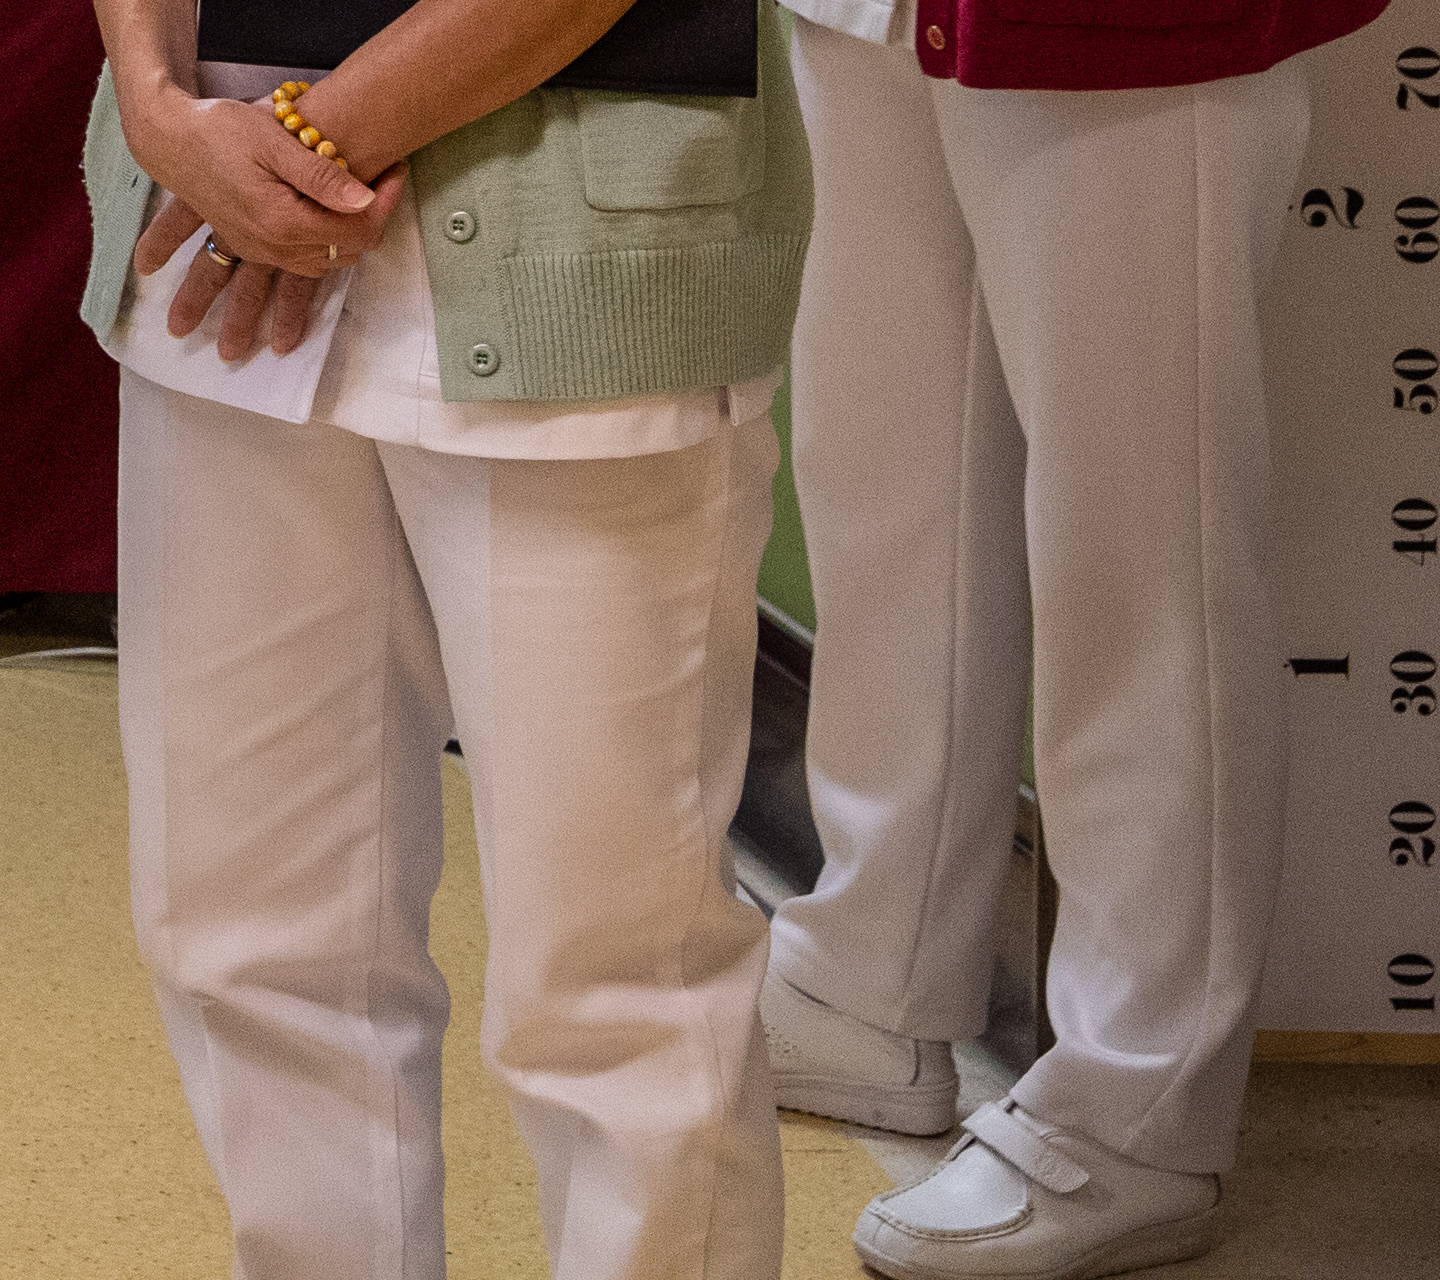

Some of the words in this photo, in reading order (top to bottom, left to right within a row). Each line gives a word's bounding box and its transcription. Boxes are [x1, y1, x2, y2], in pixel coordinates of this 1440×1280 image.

[1395, 46, 1440, 112] 70
[1299, 186, 1365, 230] 2
[1394, 196, 1440, 264] 60
[1392, 348, 1438, 415] 50
[1391, 497, 1438, 566] 40
[1288, 652, 1350, 679] 1
[1389, 649, 1436, 716] 30
[1388, 800, 1436, 868] 20
[1387, 952, 1436, 1012] 10
